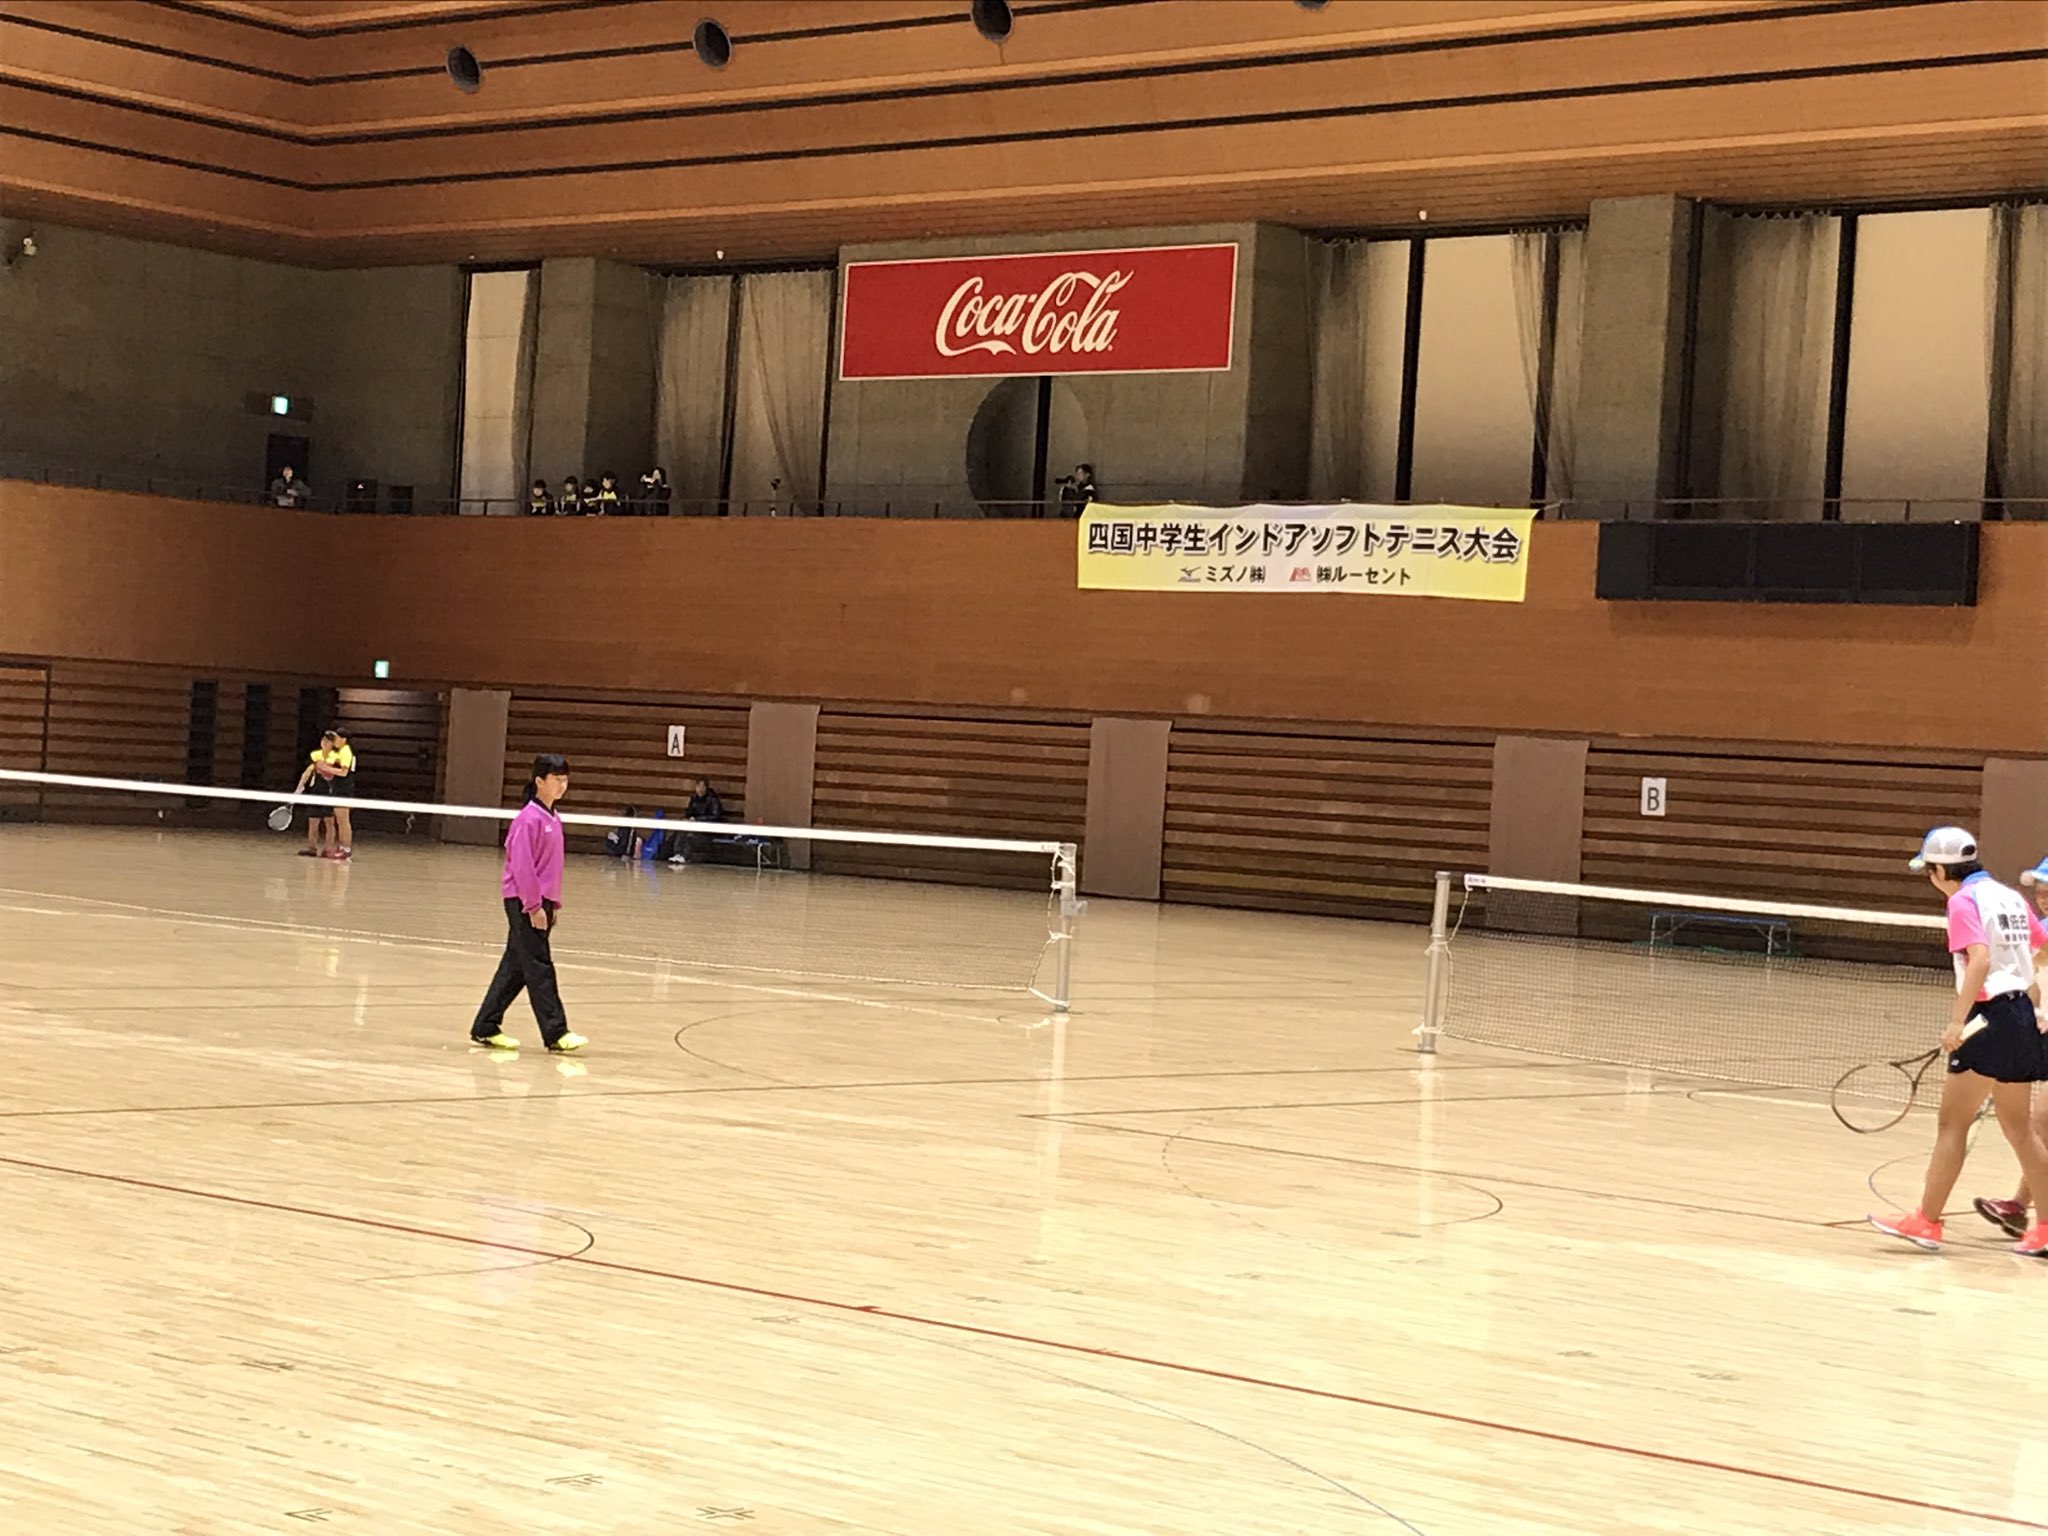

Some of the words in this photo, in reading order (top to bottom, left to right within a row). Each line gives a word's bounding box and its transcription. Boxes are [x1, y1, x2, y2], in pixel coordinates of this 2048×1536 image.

[1088, 523, 1519, 560] 四国中学生インドアソフトテニス大会
[670, 732, 681, 755] A
[1647, 786, 1660, 811] B
